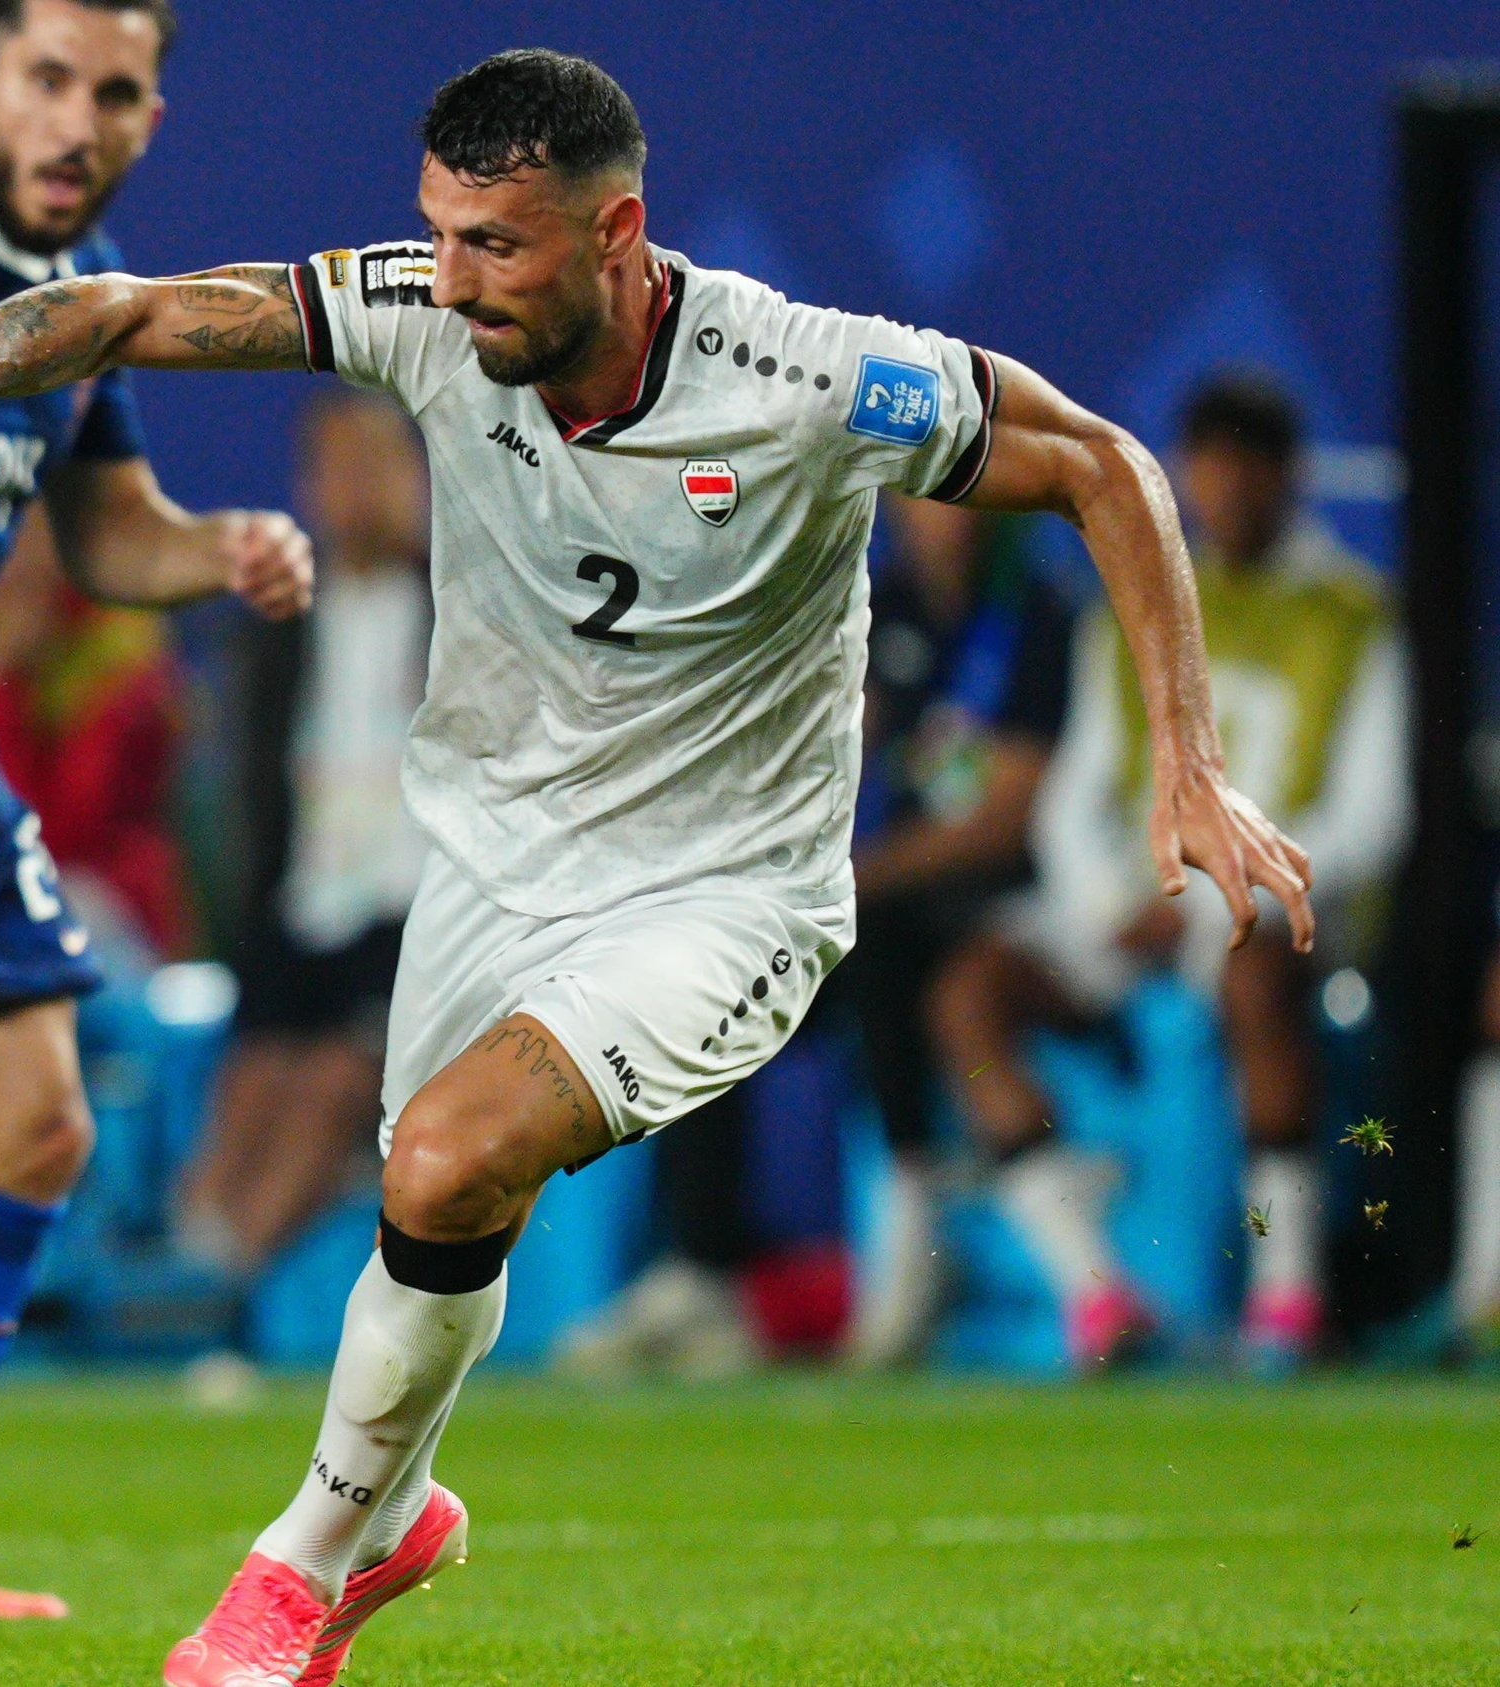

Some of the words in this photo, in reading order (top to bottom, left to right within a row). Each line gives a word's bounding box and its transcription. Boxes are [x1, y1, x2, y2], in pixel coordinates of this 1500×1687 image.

[335, 259, 344, 283] DEBUT
[366, 260, 377, 290] 2026
[902, 386, 923, 425] PEACE
[920, 399, 931, 420] FIFA
[486, 421, 540, 468] JAKO
[691, 465, 724, 473] IRAQ
[570, 553, 639, 647] 2
[602, 1044, 640, 1103] JAKO
